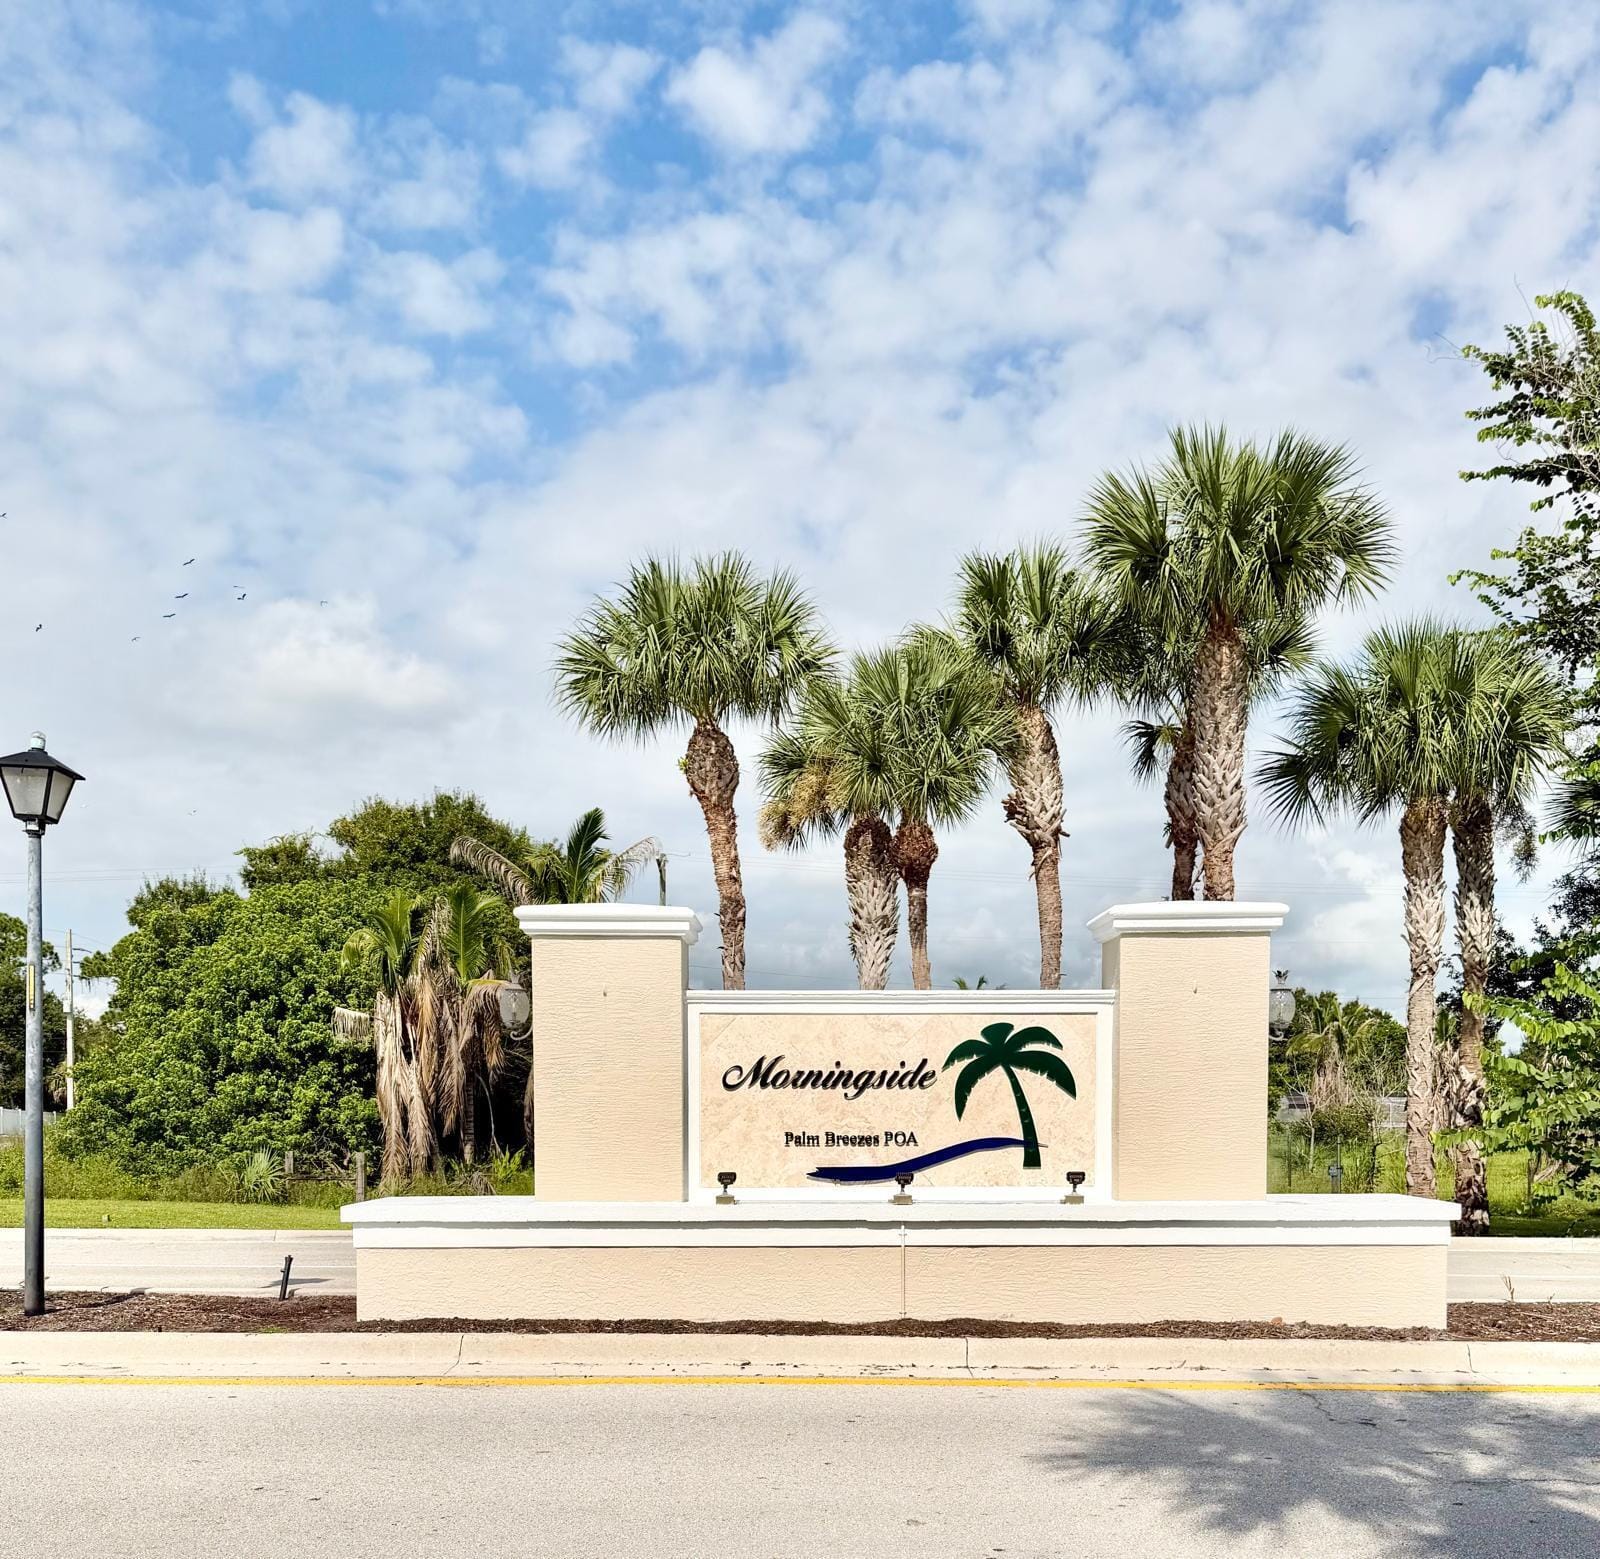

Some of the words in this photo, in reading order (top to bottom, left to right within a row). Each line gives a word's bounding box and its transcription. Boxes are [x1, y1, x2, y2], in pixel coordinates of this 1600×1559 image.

[722, 1055, 937, 1100] Morningside
[784, 1131, 820, 1147] Palm
[825, 1131, 880, 1147] Breezes
[884, 1131, 919, 1147] POA
